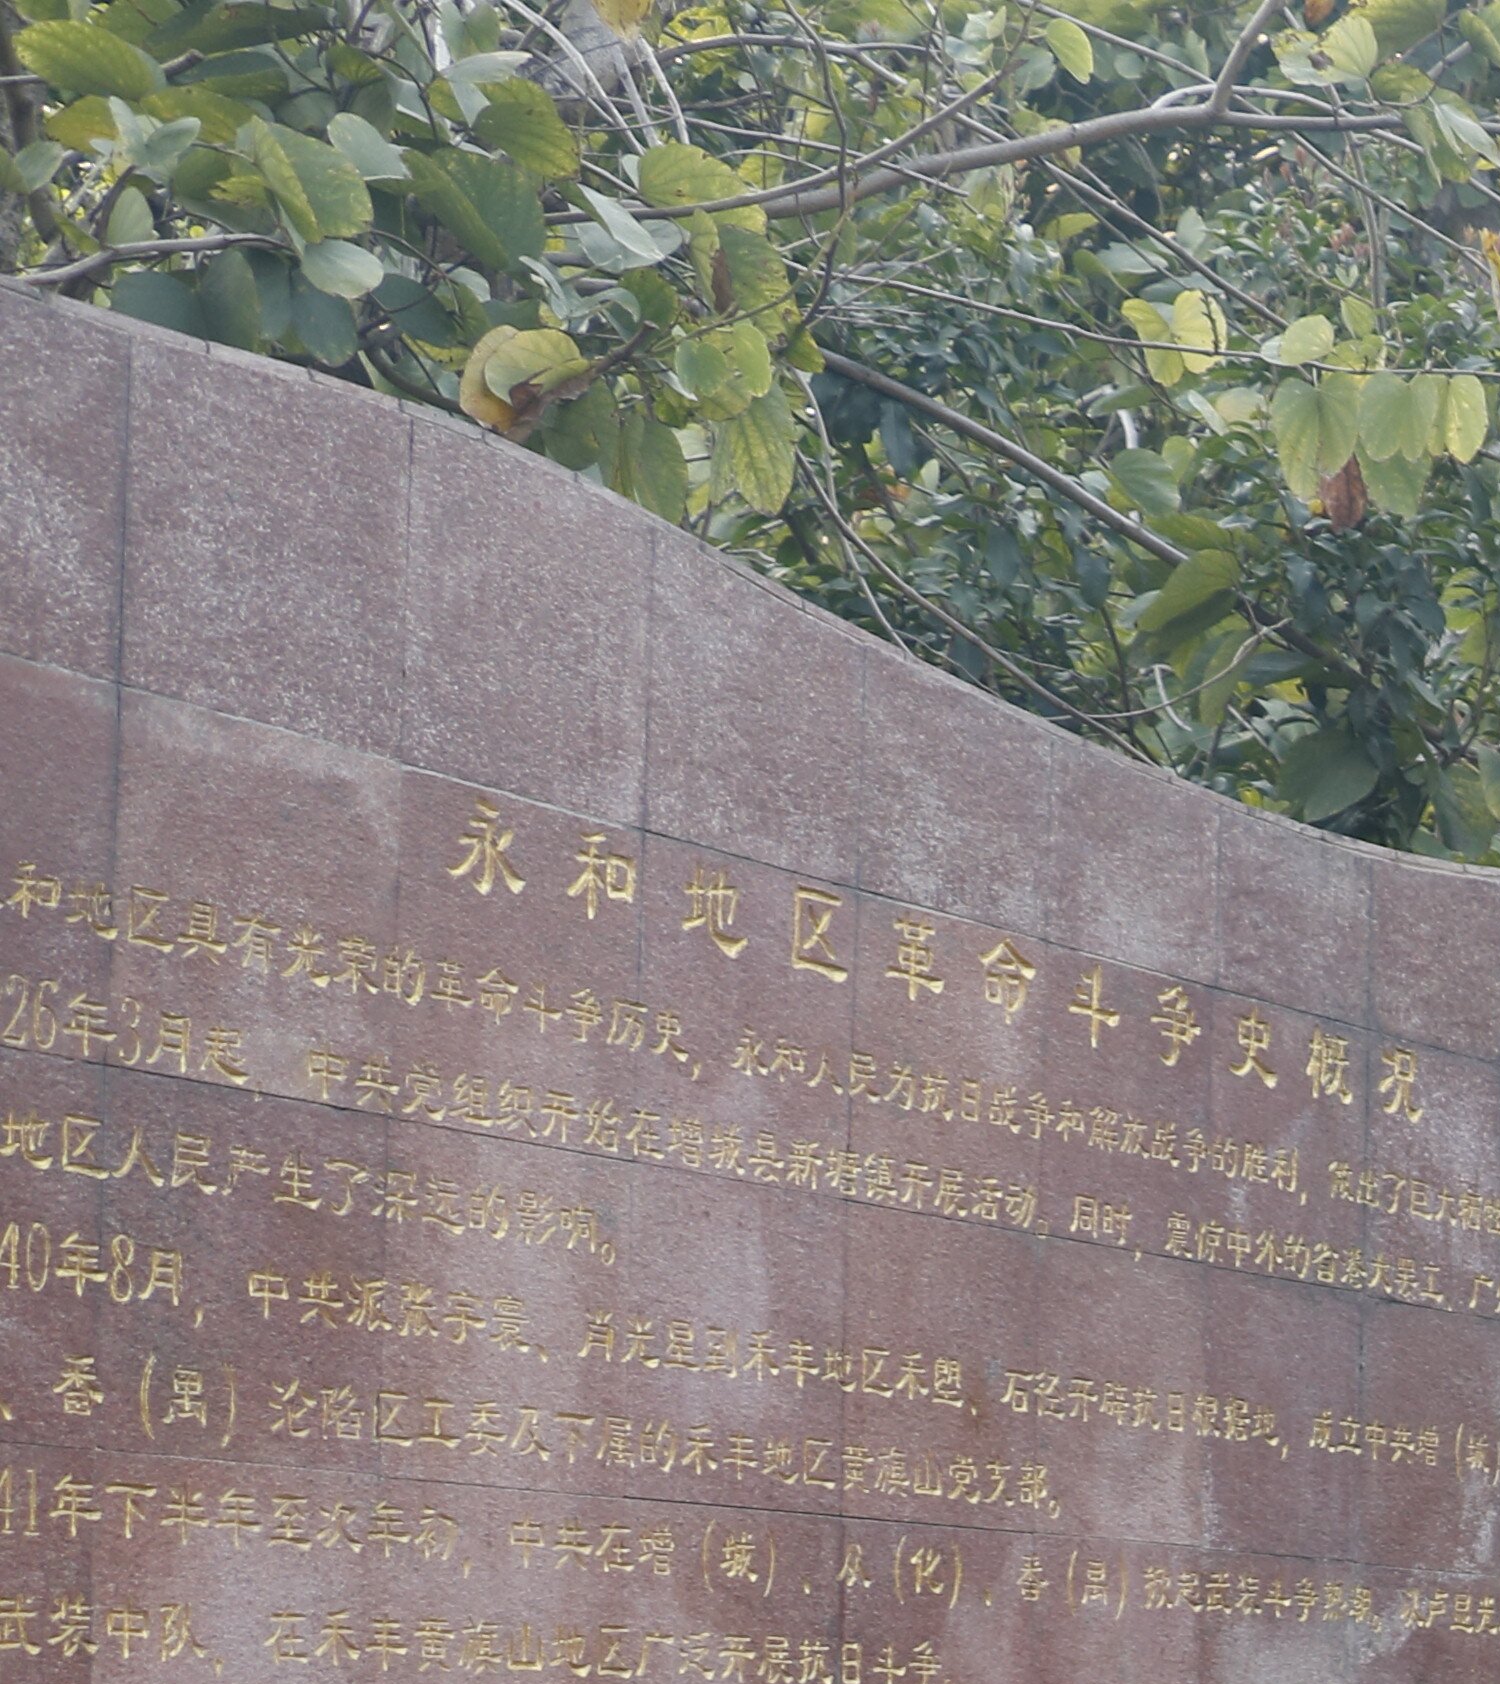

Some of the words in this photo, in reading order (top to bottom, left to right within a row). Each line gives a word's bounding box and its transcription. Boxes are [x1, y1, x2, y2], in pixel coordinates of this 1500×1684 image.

[449, 800, 1424, 1124] 永和地区革命斗争史概况
